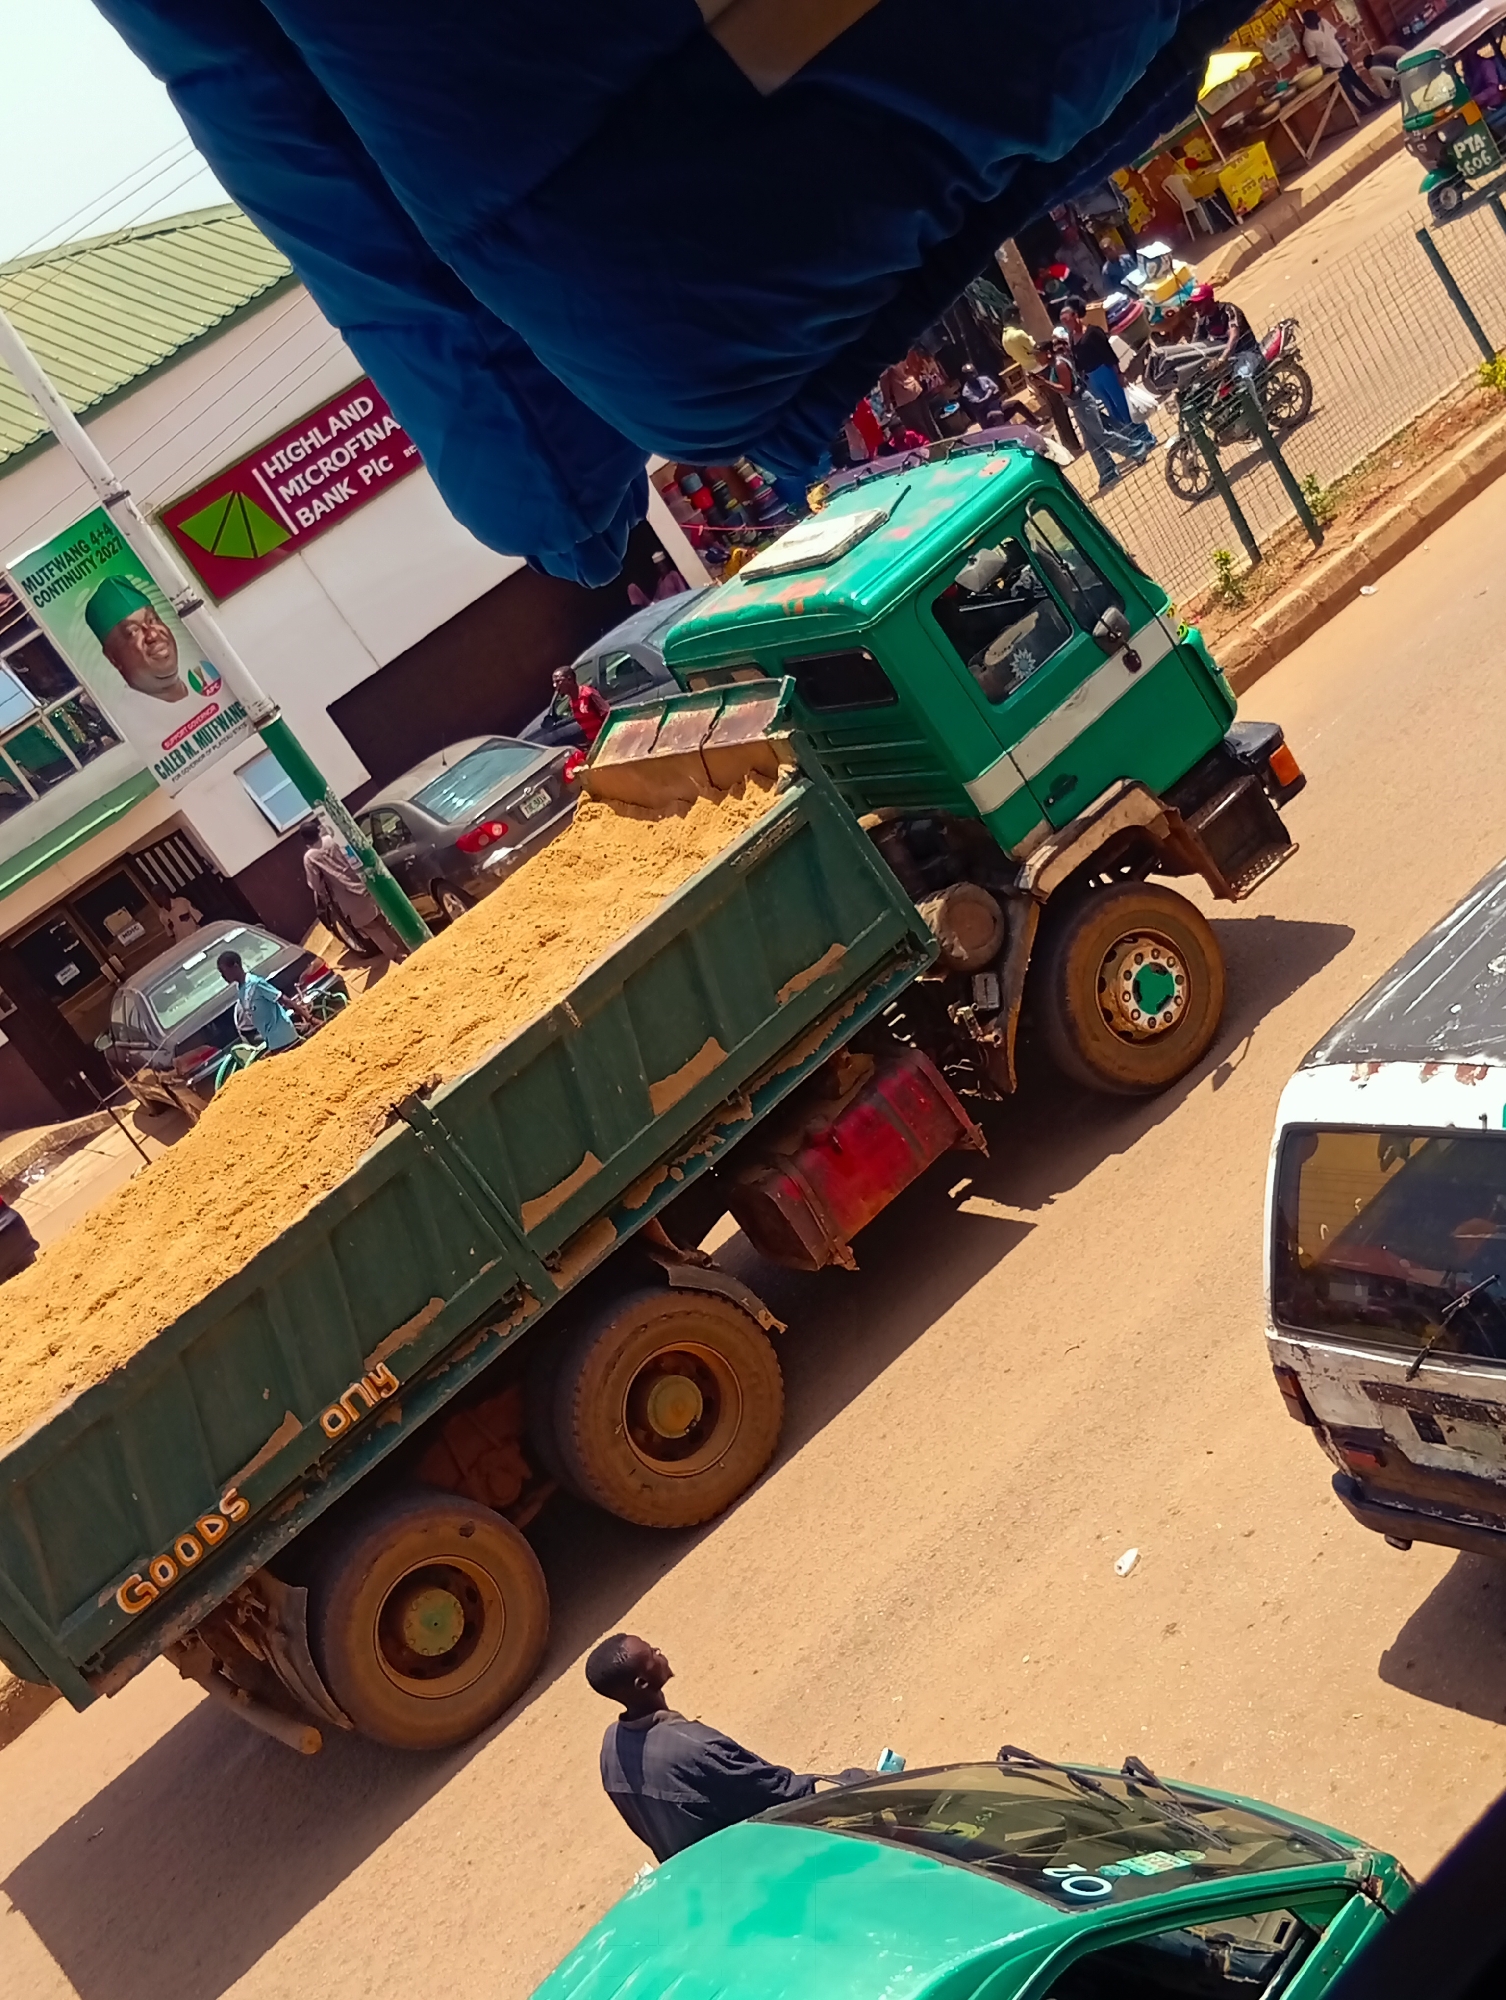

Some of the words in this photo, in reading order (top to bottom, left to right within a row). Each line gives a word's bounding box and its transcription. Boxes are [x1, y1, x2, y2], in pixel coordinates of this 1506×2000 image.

[261, 396, 374, 480] HIGHLAND
[278, 415, 401, 504] MICROFINA
[295, 476, 358, 528] BANK
[21, 539, 92, 595] MUTFWANG
[89, 522, 114, 546] 4+4
[33, 554, 98, 608] CONTINUITY
[95, 536, 123, 564] 2027
[205, 683, 220, 696] APC
[154, 749, 187, 780] CALEB
[180, 740, 199, 760] M.
[192, 701, 248, 751] MUTFWANG
[164, 725, 189, 749] SUPPORT
[187, 704, 217, 730] GOVERNOR
[181, 753, 206, 775] GOVERNOR
[116, 1487, 249, 1614] GOODS
